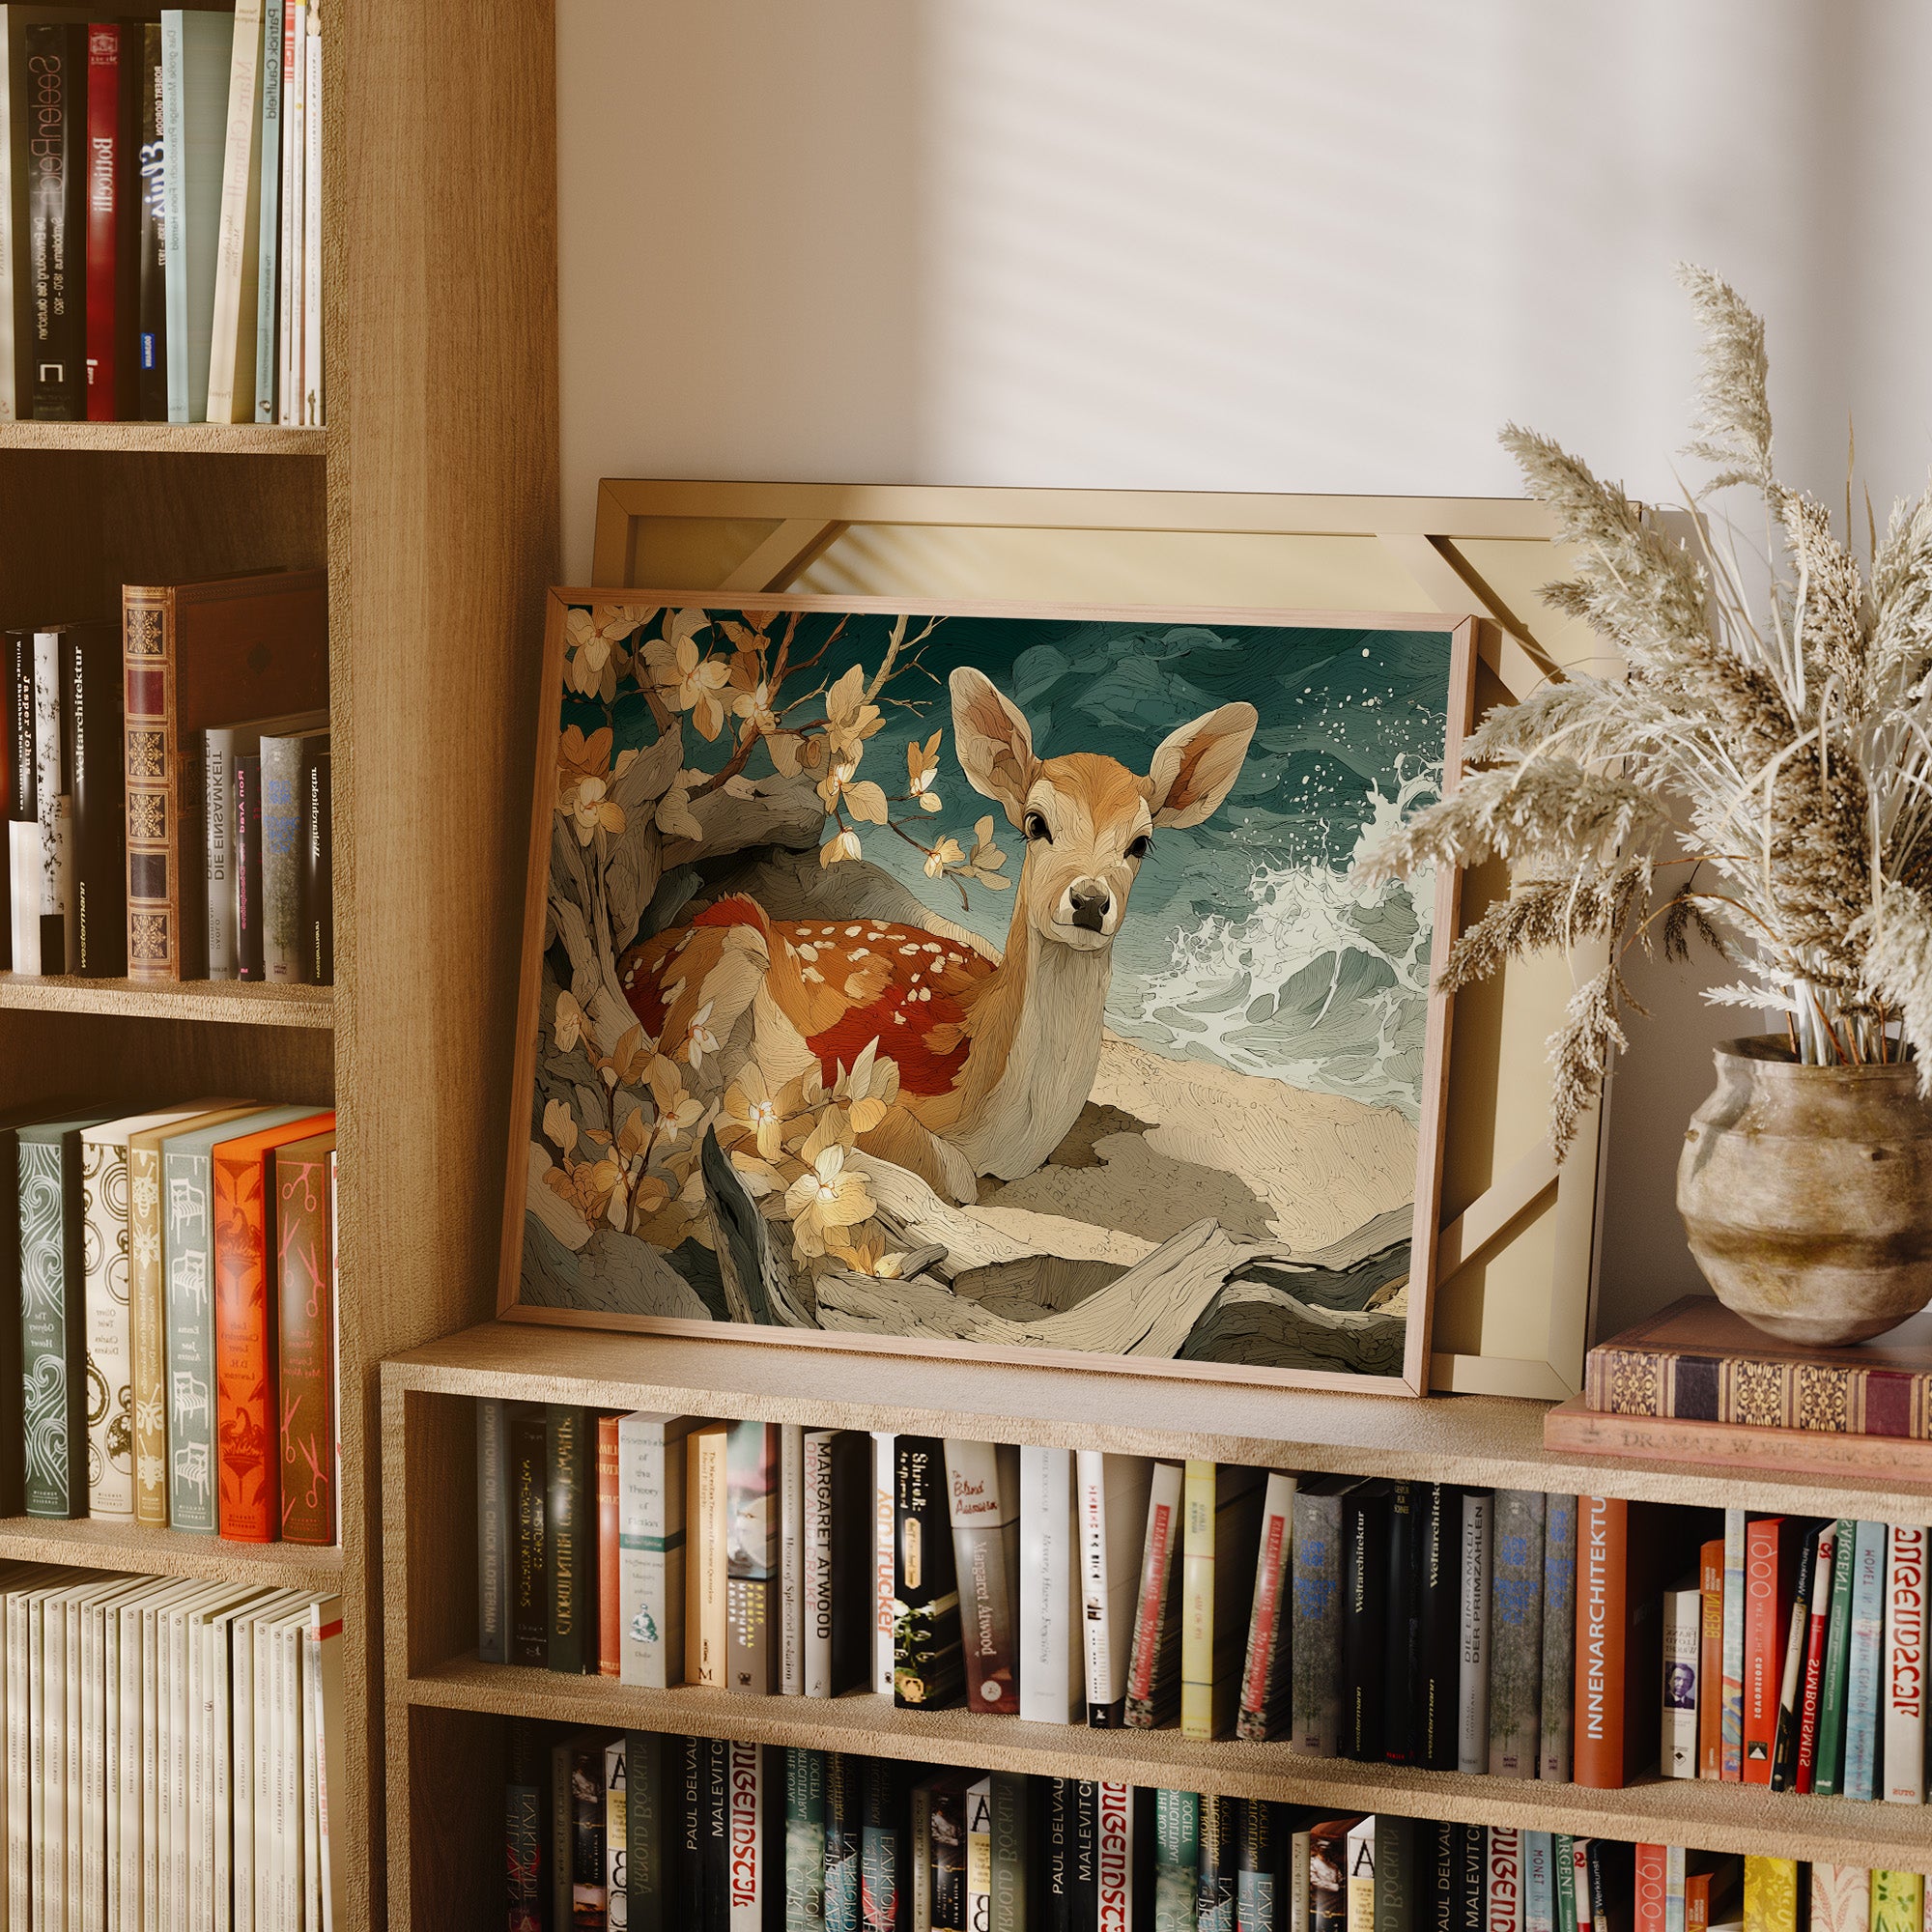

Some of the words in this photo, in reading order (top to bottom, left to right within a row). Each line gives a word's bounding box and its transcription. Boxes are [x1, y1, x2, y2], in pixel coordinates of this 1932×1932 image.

[73, 645, 84, 783] Weltarchitektur
[485, 1478, 496, 1504] OWL
[805, 1441, 817, 1492] ORYX
[817, 1442, 832, 1551] MARGARET
[805, 1496, 817, 1540] AND
[485, 1554, 497, 1633] KLOSTERMAN
[805, 1546, 817, 1612] CRAKE
[972, 1541, 990, 1600] Margaret
[1354, 1510, 1365, 1614] Weltarchitektur
[1464, 1520, 1474, 1629] EINSAMKEIT
[1471, 1506, 1484, 1622] PRIMZAHLEN
[817, 1556, 832, 1639] ATWOOD
[979, 1605, 997, 1655] Atwood
[1587, 1496, 1607, 1740] INNENARCHITEKTU
[1464, 1634, 1473, 1664] DIE
[1472, 1627, 1482, 1664] DER
[1427, 1678, 1435, 1759] westermann
[686, 1736, 697, 1802] DELVAU
[686, 1807, 697, 1850] PAUL
[1052, 1777, 1065, 1845] DELVAU
[1052, 1851, 1065, 1895] PAUL
[1437, 1821, 1451, 1890] DELVAU
[1533, 1849, 1545, 1885] MONET
[1592, 1861, 1604, 1908] Werkkunst
[1636, 1856, 1662, 1918] 1900
